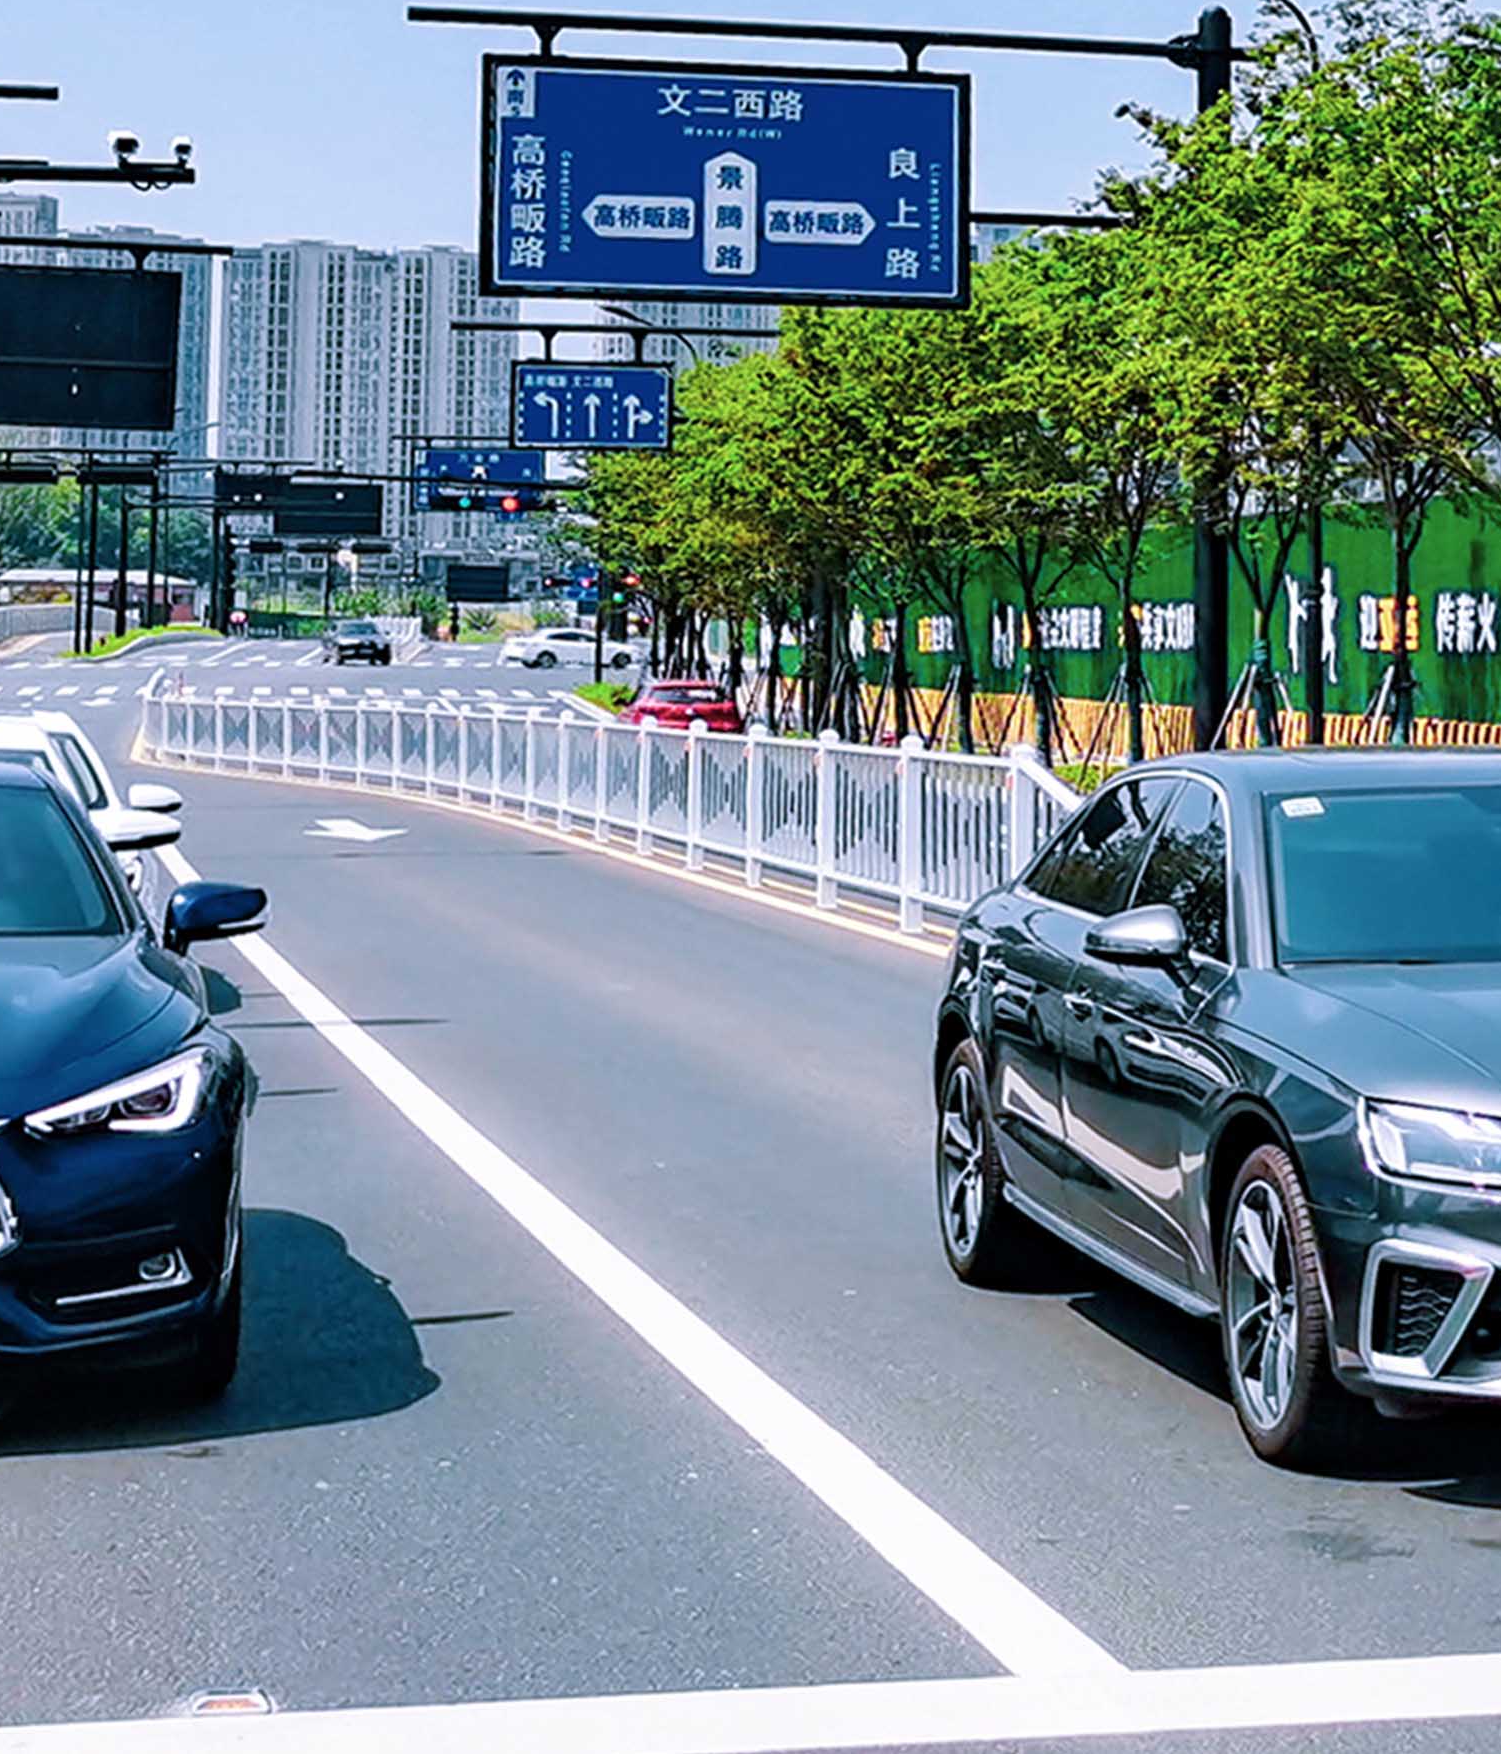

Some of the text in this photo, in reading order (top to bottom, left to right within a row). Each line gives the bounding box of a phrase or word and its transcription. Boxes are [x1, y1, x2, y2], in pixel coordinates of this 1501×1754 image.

[657, 83, 803, 121] 文二西路
[509, 134, 546, 269] 高桥畈路
[593, 203, 691, 230] 高桥畈路
[715, 165, 744, 269] 景腾路
[769, 209, 865, 235] 高桥畈路
[884, 147, 921, 280] 良上路
[1435, 591, 1497, 653] 传薪火
